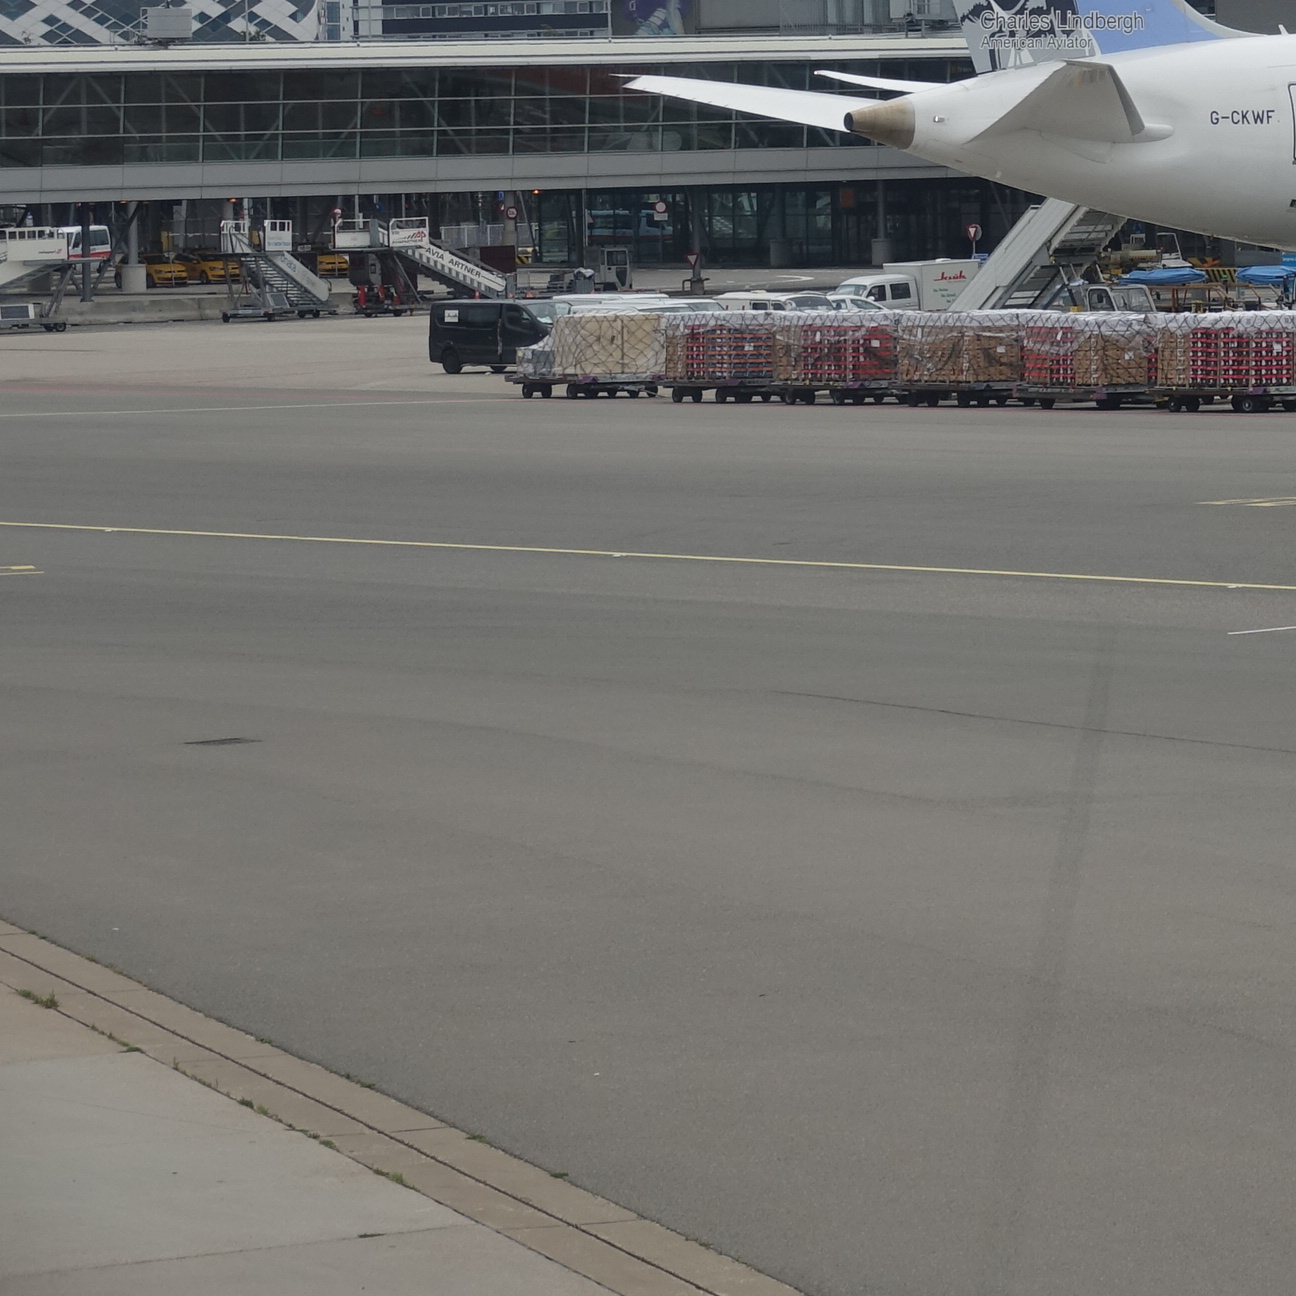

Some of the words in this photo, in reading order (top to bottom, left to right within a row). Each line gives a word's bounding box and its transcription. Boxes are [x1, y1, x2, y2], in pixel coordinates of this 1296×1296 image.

[980, 10, 1051, 30] Charles
[1056, 10, 1144, 35] Lindbergh
[980, 36, 1044, 49] American
[1046, 35, 1093, 49] Aviator
[1210, 110, 1275, 125] G-CKWF
